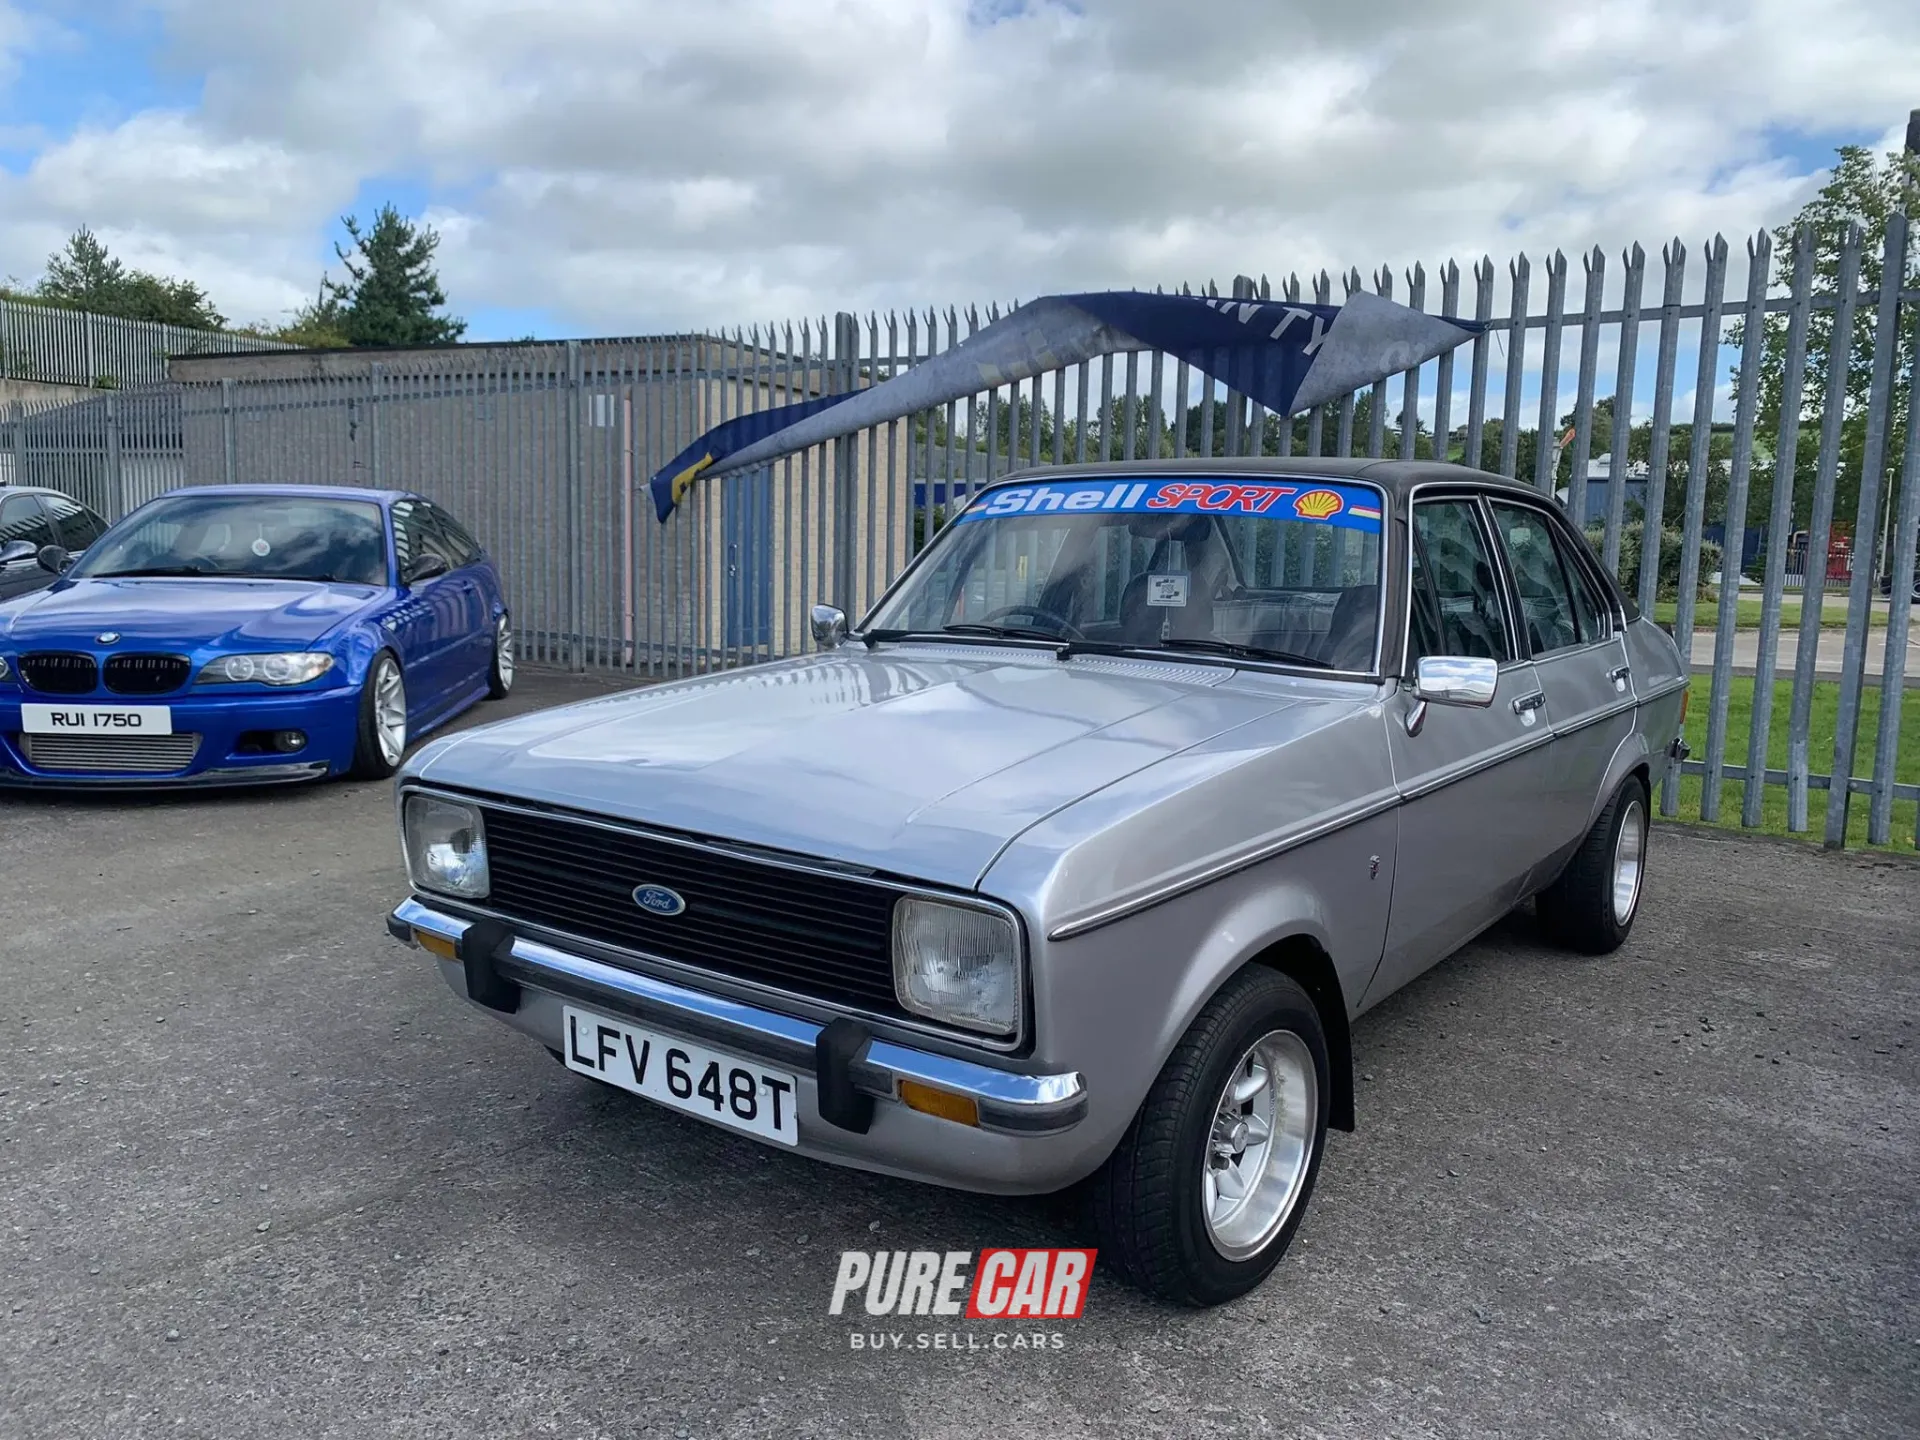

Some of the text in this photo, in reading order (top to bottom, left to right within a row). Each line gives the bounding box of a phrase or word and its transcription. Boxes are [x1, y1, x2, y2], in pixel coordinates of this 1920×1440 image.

[985, 483, 1299, 515] Shell SPORT
[51, 712, 142, 727] RUI 1750
[643, 889, 671, 910] Ford
[569, 1015, 791, 1131] LFV 648T
